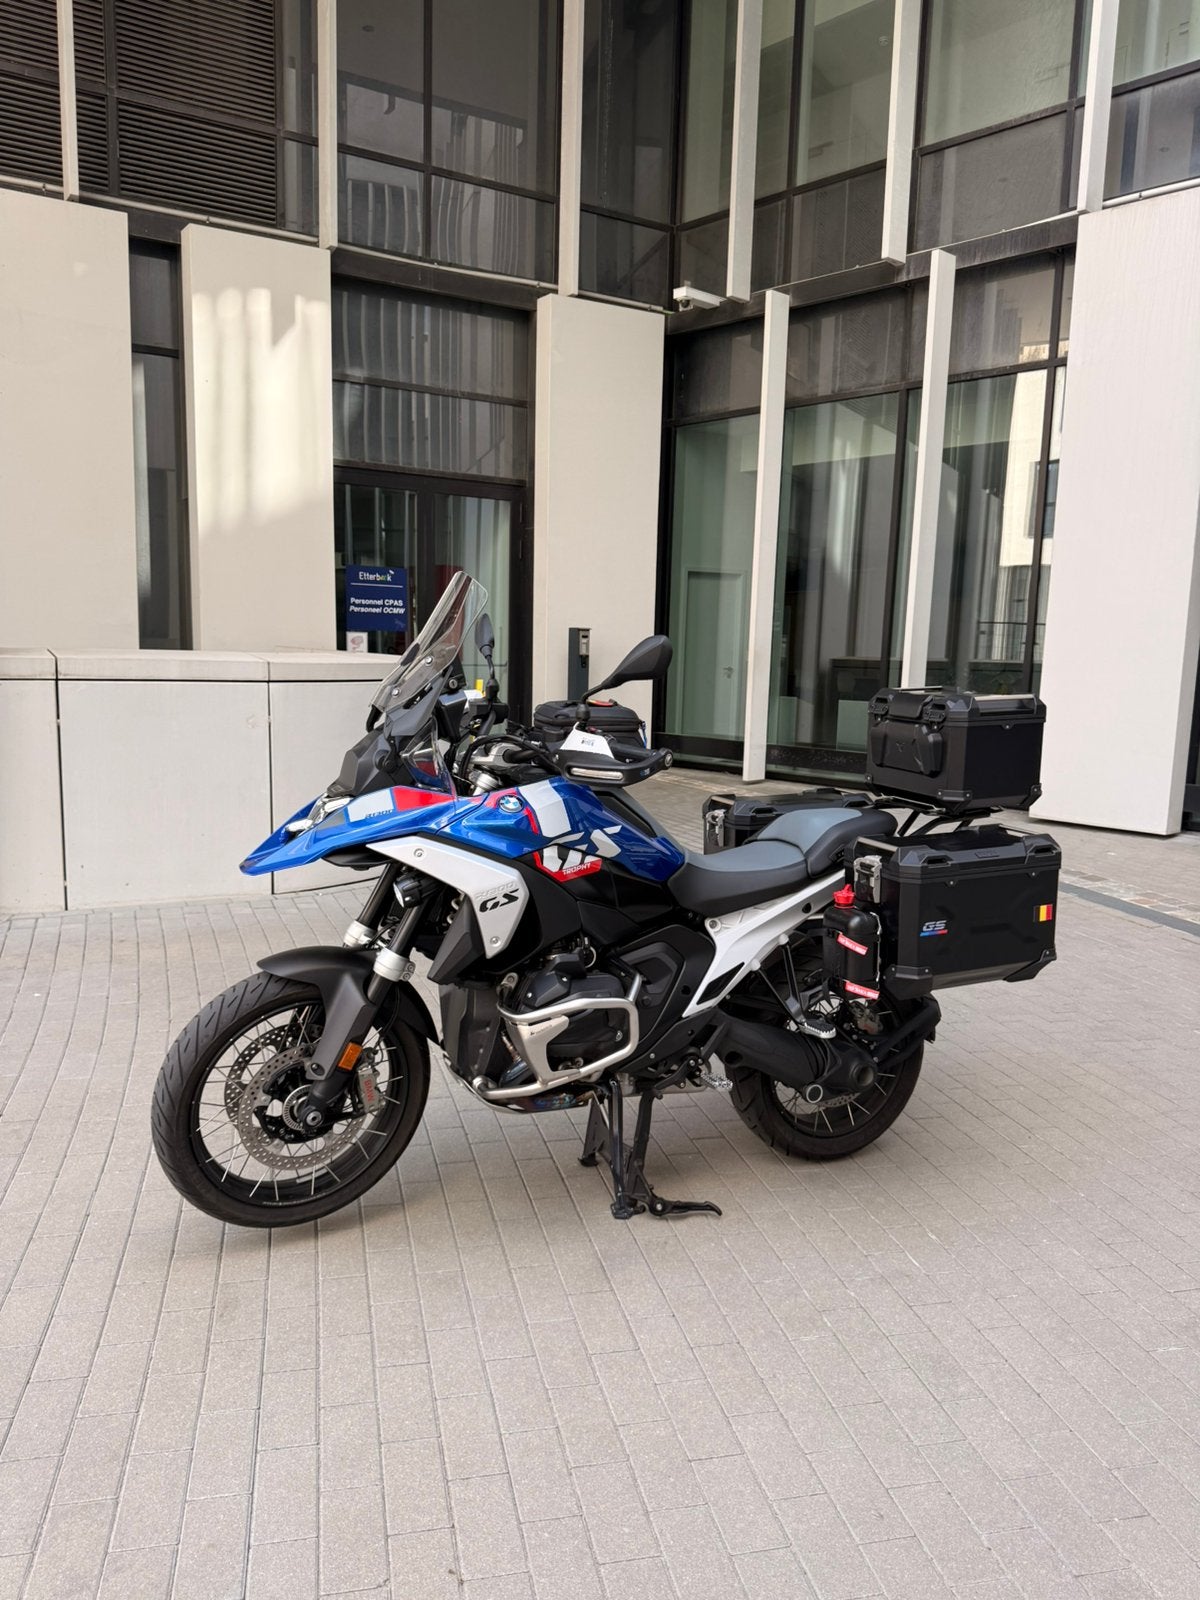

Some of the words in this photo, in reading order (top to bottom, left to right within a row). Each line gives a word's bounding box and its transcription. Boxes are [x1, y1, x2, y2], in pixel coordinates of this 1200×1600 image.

[350, 597, 383, 605] Personnel
[384, 599, 404, 607] CPAS
[349, 605, 382, 613] Personeel
[383, 606, 406, 614] OCMW
[562, 862, 592, 876] TROPHY
[479, 888, 520, 913] GS
[922, 919, 947, 932] GS
[364, 1079, 375, 1102] BMW
